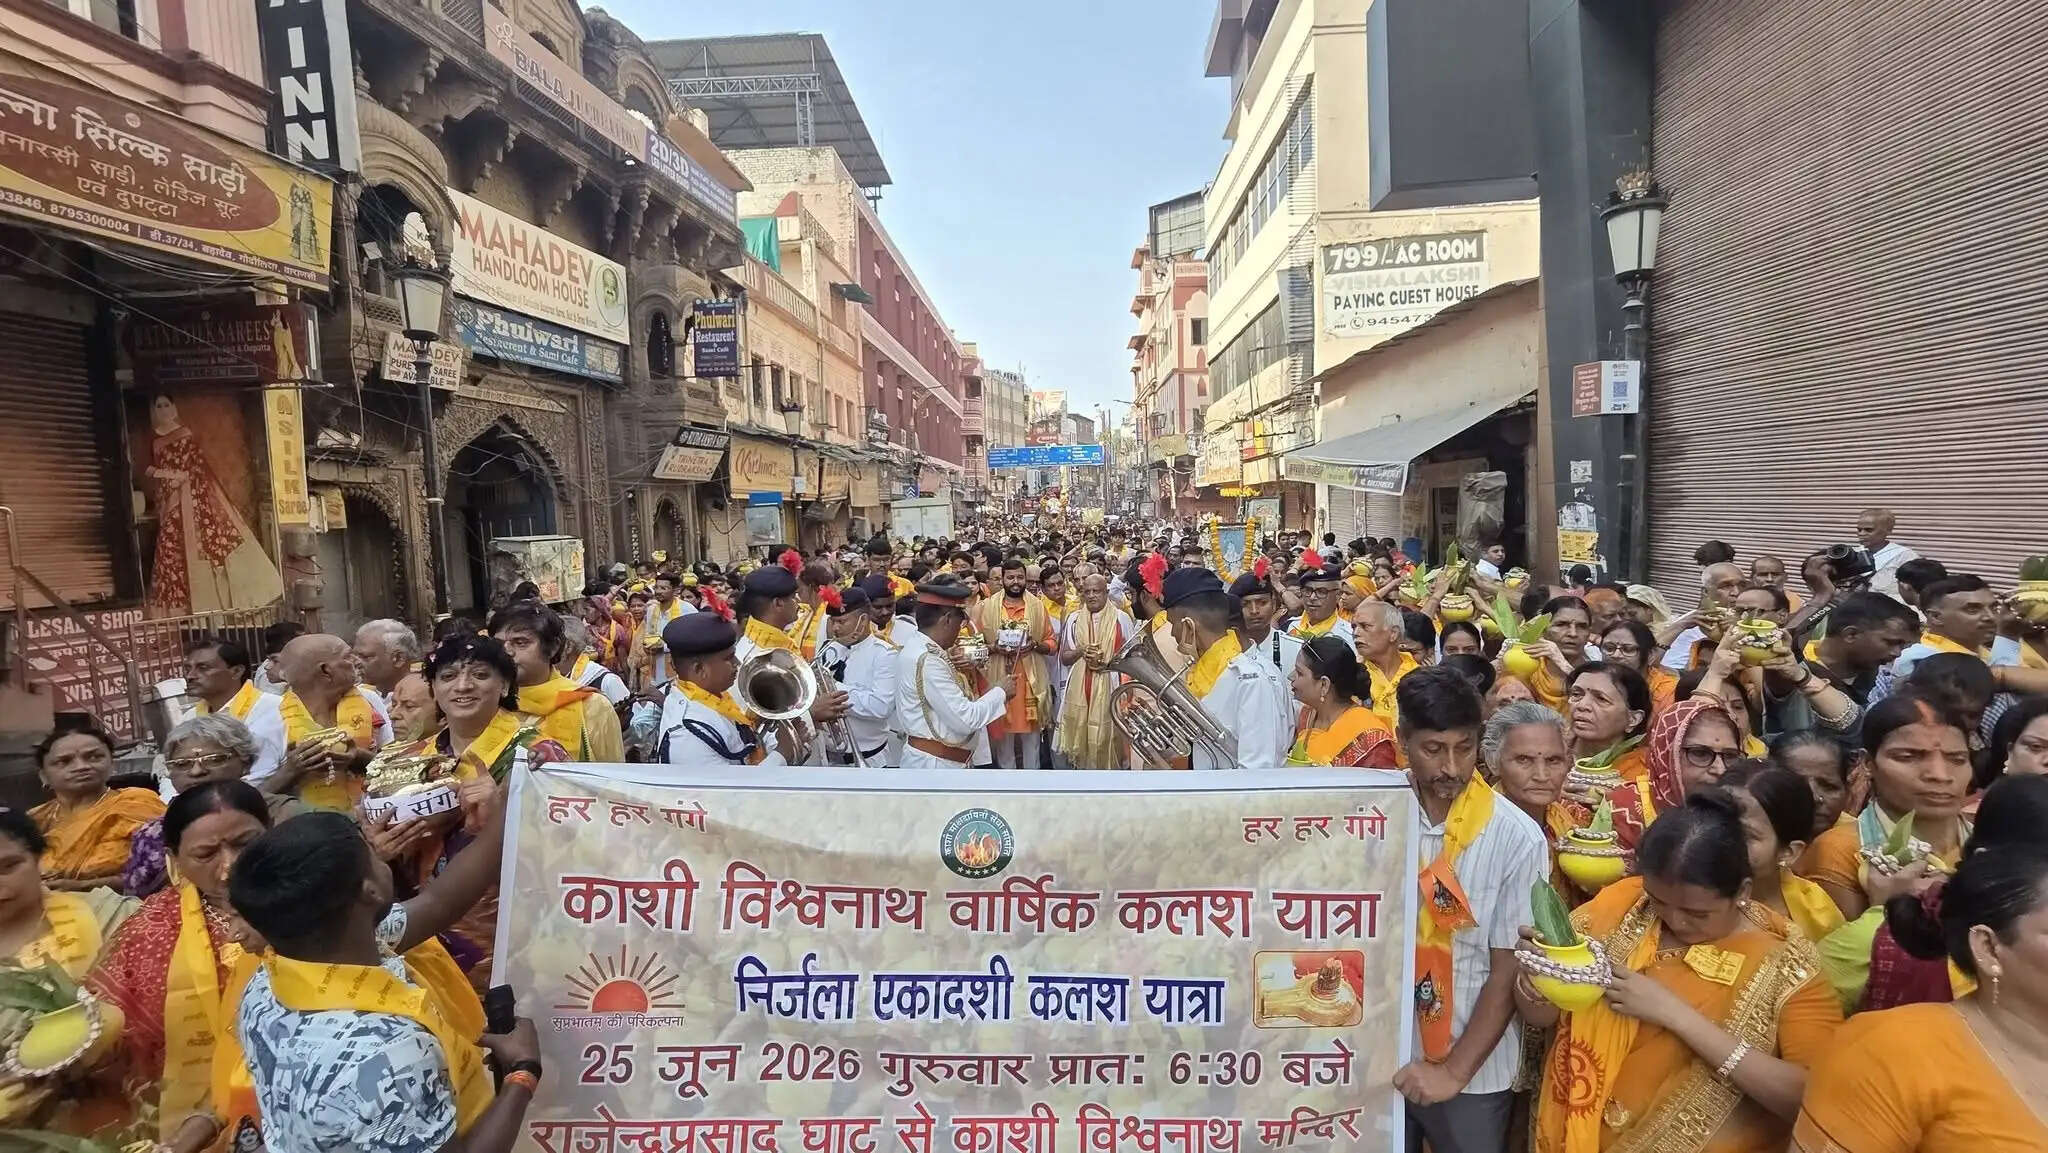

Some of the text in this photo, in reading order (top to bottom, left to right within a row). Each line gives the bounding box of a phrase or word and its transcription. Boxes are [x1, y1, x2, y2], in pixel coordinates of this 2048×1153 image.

[71, 105, 171, 167] सिल्क
[182, 152, 248, 198] साड़ी
[650, 134, 690, 178] 2D/3D
[77, 174, 107, 198] एवं
[50, 203, 130, 233] 8795300004
[213, 196, 241, 220] सूट
[459, 200, 595, 287] MAHADEV
[1397, 242, 1421, 265] AC
[1426, 238, 1477, 262] ROOM
[472, 247, 549, 295] HANDLOOM
[552, 279, 589, 309] HOUSE
[1331, 266, 1480, 290] VISHALAKSHI
[1334, 285, 1479, 310] PAYING GUEST HOUSE
[217, 319, 271, 342] SAREES
[474, 306, 579, 354] Phulwari
[694, 310, 736, 329] Phulwari
[1367, 313, 1437, 327] 945473
[393, 337, 459, 362] MAADEV
[695, 331, 735, 343] Restaurent
[433, 366, 457, 379] SAREE
[548, 796, 707, 832] हर हर गंगे
[1242, 805, 1387, 842] हर हर गंगे
[561, 859, 1382, 940] काशी विश्वनाथ वार्षिक कलश यात्रा
[734, 953, 1225, 1025] निर्जला एकादशी कलश यात्रा
[607, 1013, 623, 1027] की
[627, 1013, 685, 1027] परिकल्पना
[580, 1044, 633, 1084] 25
[656, 1045, 741, 1099] जून
[760, 1043, 861, 1083] 2026
[880, 1053, 1032, 1097] गुरुवार
[1168, 1052, 1262, 1086] 6:30
[1280, 1038, 1356, 1086] बजे
[530, 1102, 1362, 1153] राजेन्द्रप्रसाद घाट से काशी विश्वनाथ मन्दिर
